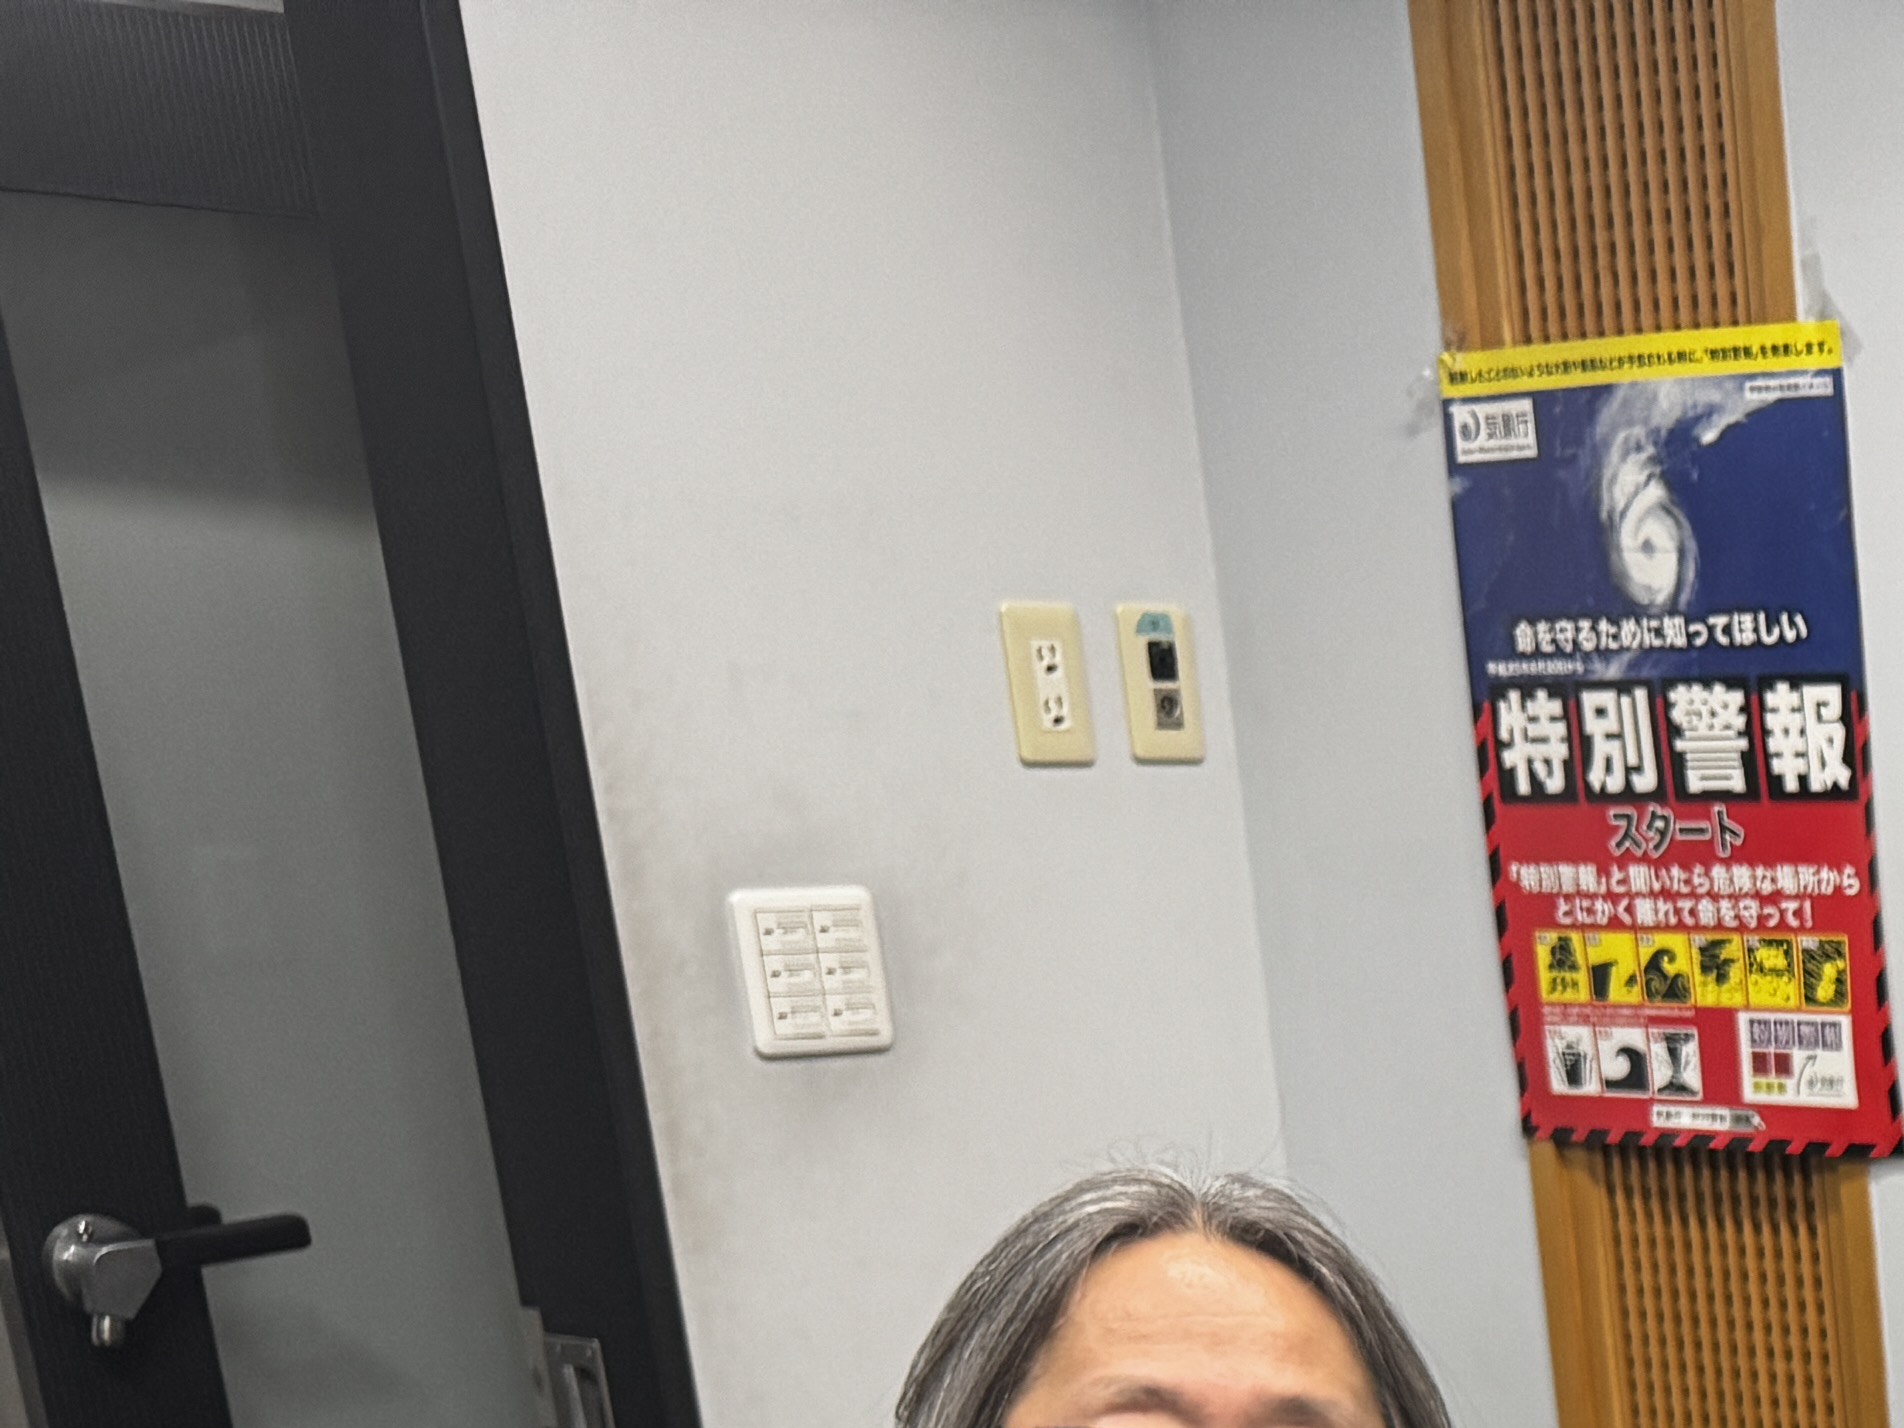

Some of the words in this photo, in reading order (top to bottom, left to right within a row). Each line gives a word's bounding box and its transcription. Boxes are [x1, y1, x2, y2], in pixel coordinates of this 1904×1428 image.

[1514, 612, 1808, 654] 命を守るために知ってほしい
[1498, 680, 1852, 797] 特別警報
[1607, 803, 1745, 859] スタート
